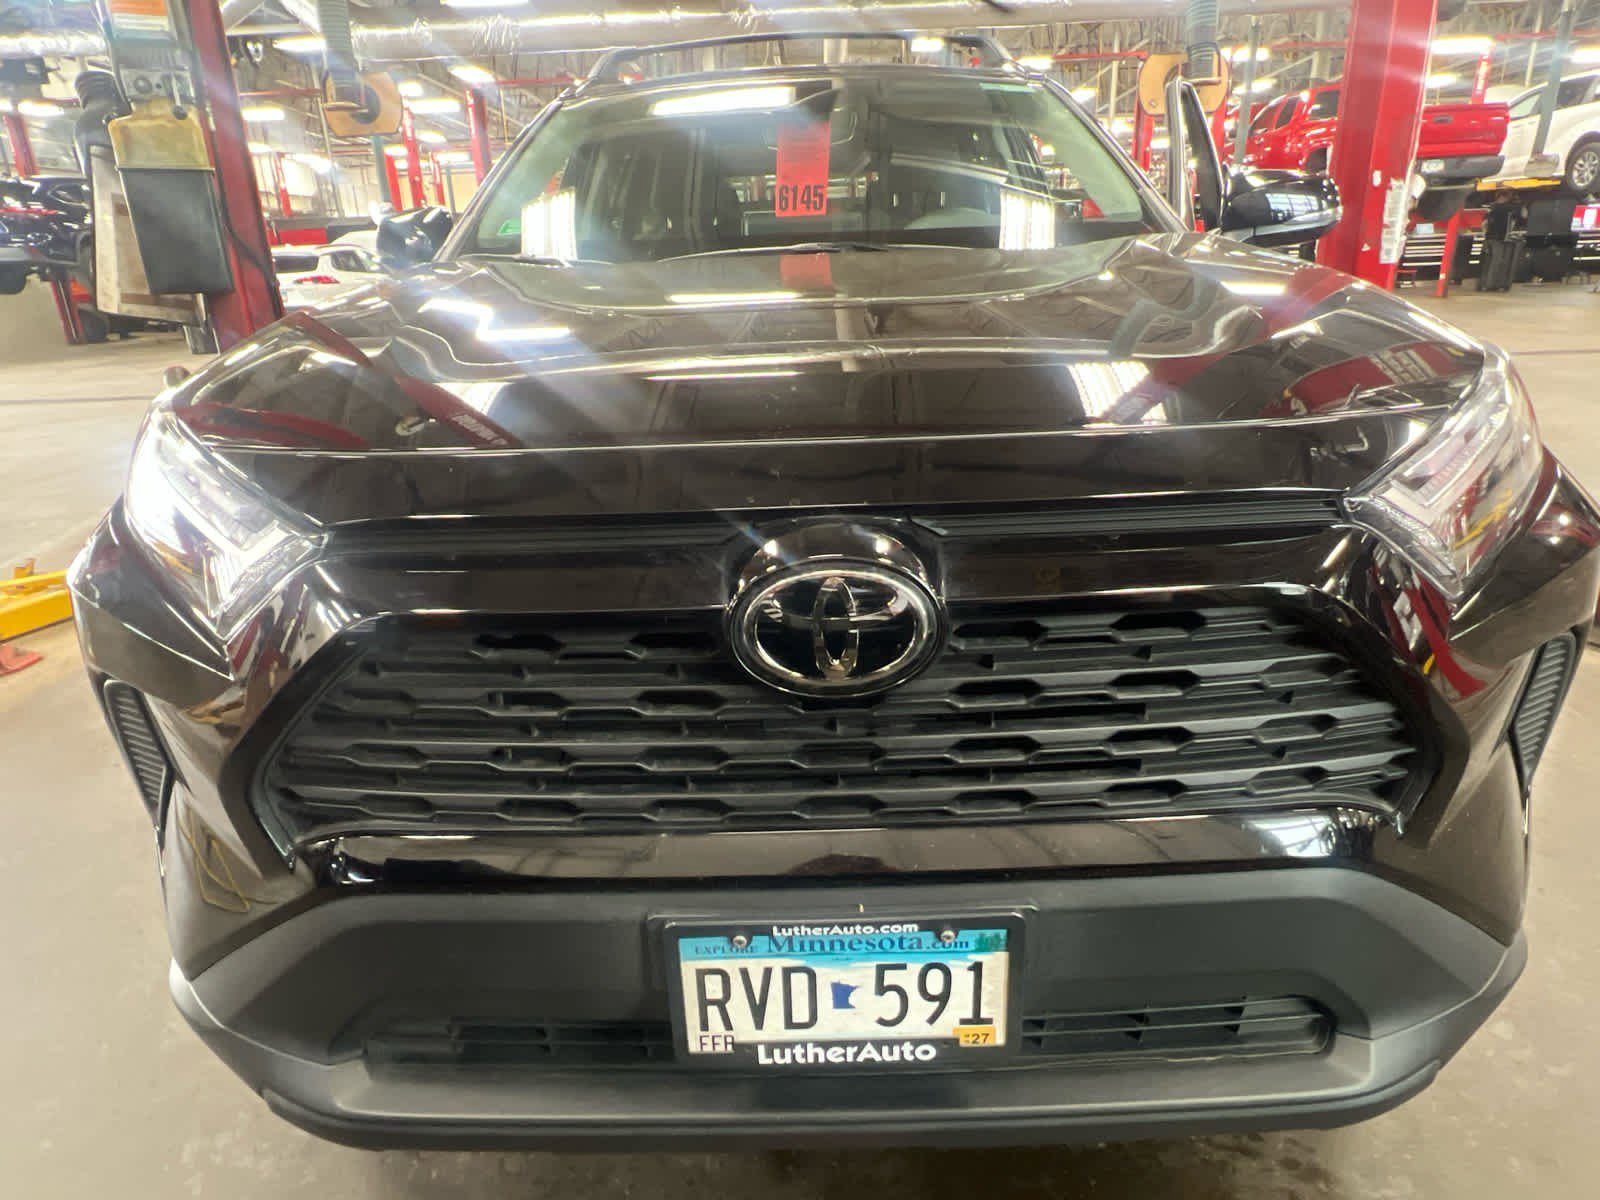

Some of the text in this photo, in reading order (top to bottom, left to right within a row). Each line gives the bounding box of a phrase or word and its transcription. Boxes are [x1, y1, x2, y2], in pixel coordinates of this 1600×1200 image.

[779, 184, 824, 211] 6145
[772, 924, 919, 937] LutherAuto.com
[695, 961, 994, 1031] RVD 591
[971, 1032, 990, 1045] 27
[757, 1041, 937, 1065] LutherAuto
